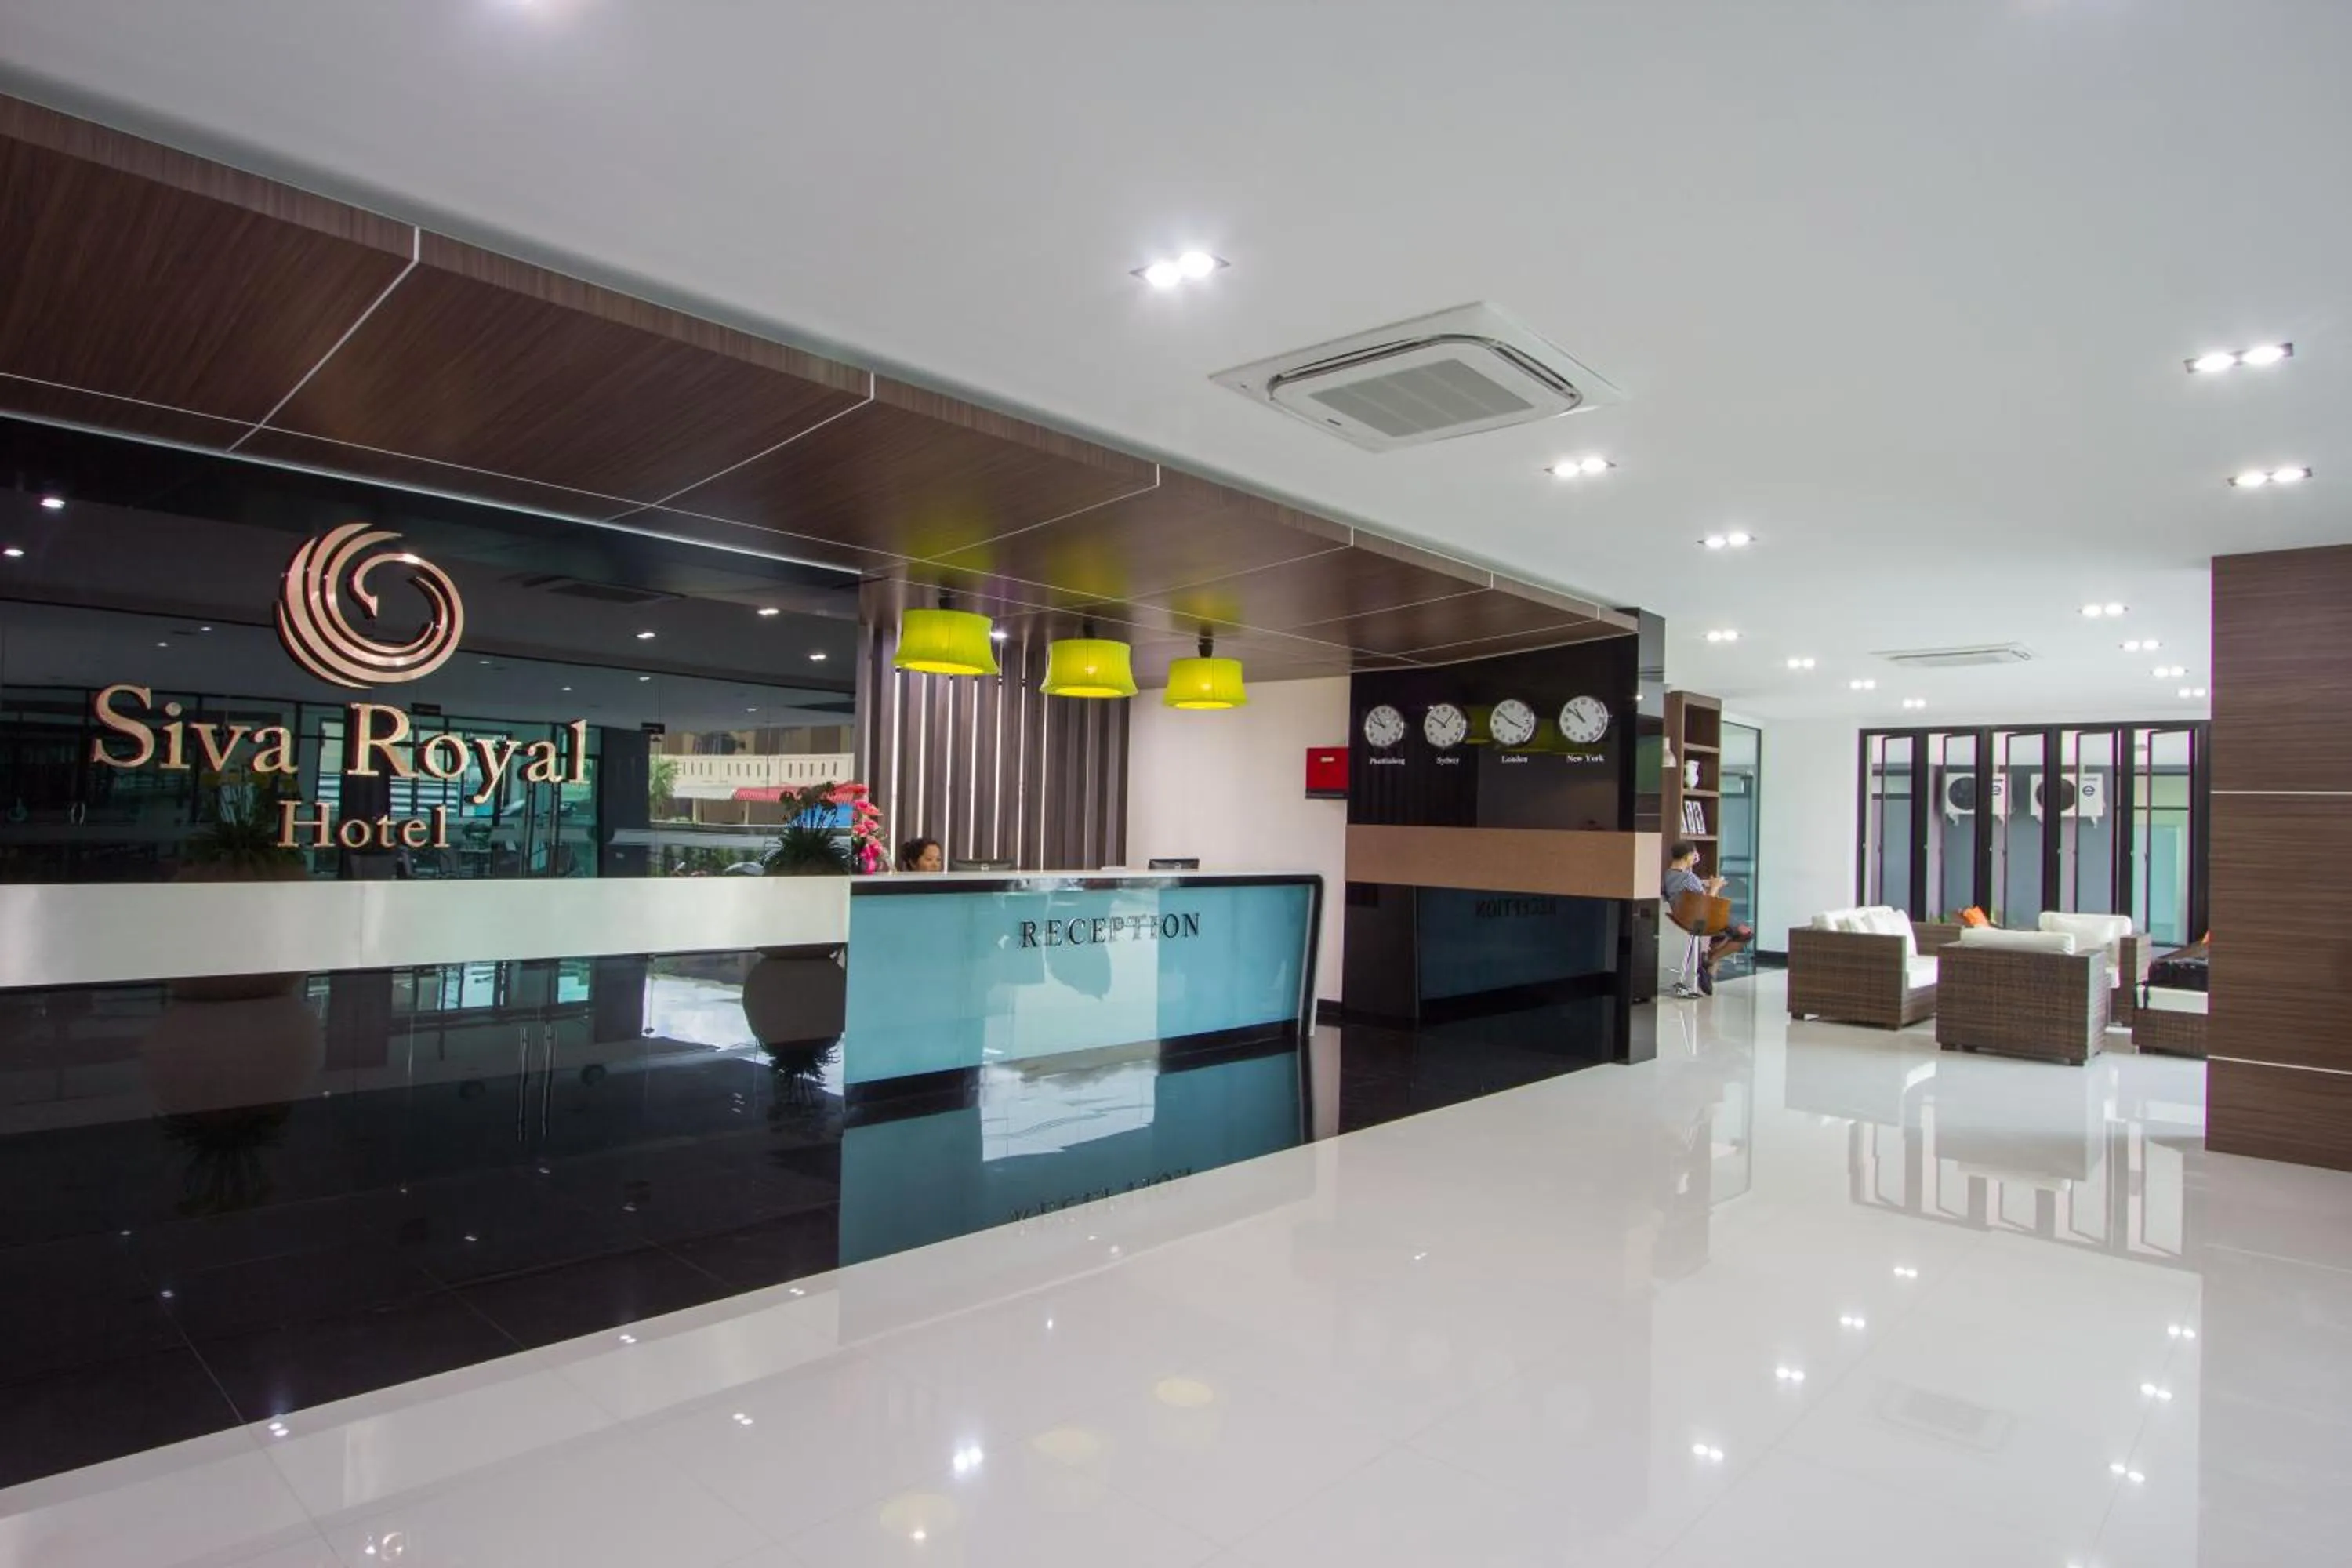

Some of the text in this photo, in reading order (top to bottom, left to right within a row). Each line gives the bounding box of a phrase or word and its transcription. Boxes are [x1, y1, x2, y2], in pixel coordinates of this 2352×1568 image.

[91, 683, 590, 805] Siva Royal
[1501, 755, 1528, 764] London
[1566, 754, 1582, 763] New
[276, 799, 451, 849] Hotel
[1019, 912, 1201, 949] RECEPTION
